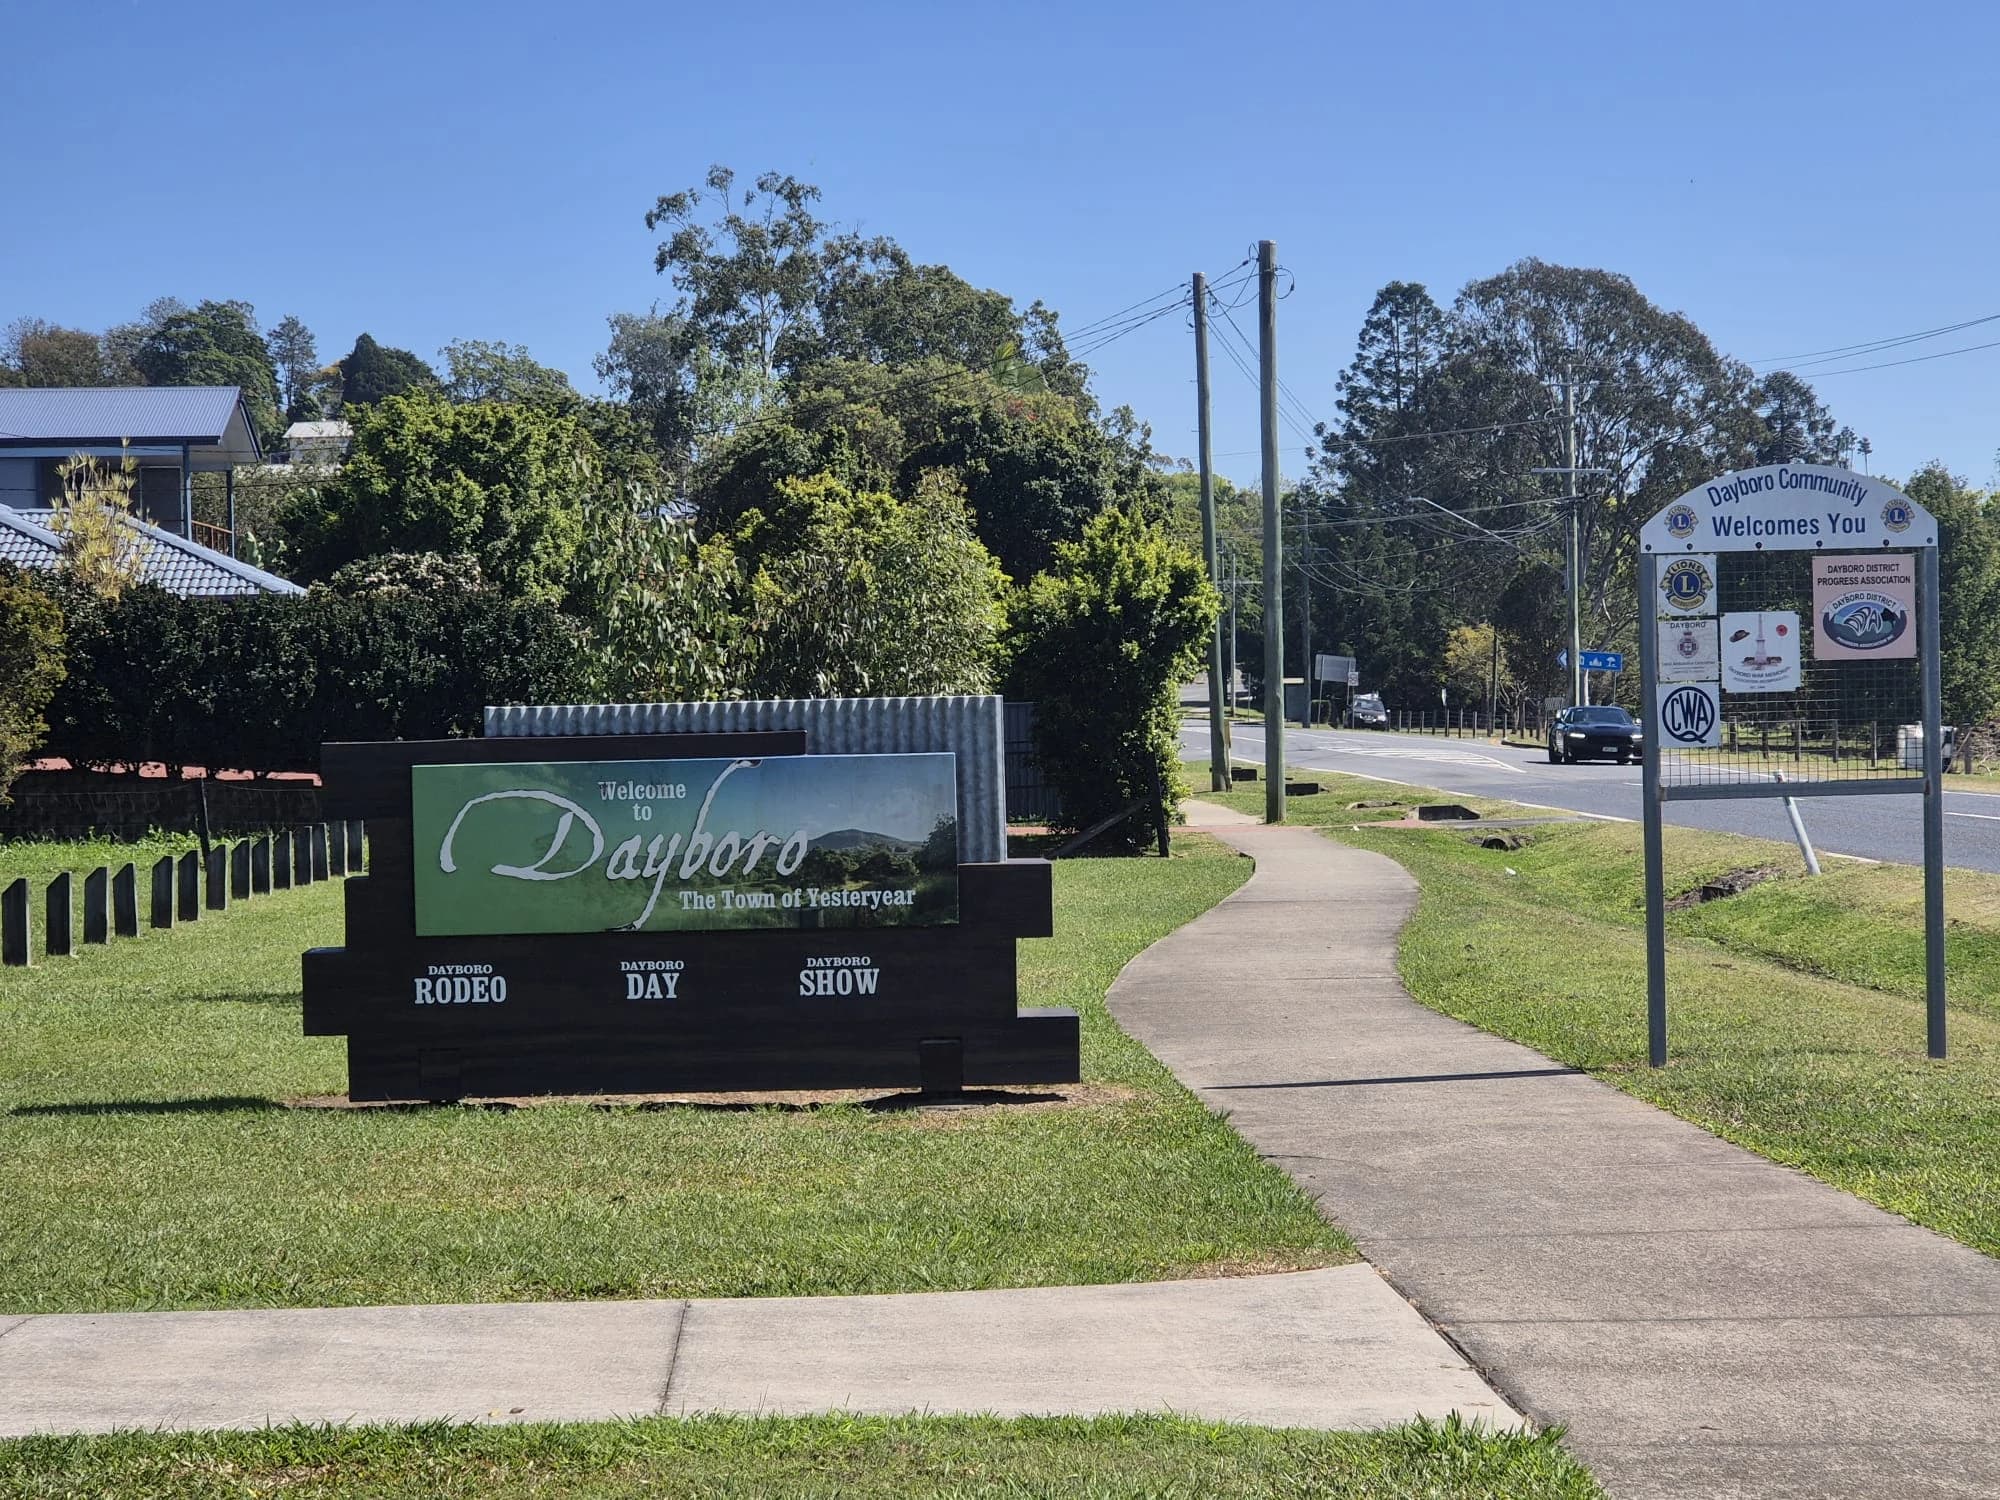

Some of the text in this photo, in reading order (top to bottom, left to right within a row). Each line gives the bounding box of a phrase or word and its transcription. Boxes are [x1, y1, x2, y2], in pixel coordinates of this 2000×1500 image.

[1707, 468, 1868, 507] Dayboro Community
[1712, 512, 1866, 536] Welcomes You
[1671, 561, 1702, 572] LIONS
[1827, 563, 1900, 574] DAYBORO DISTRICT
[1817, 575, 1911, 586] PROGRESS ASSOCIATION
[1832, 593, 1897, 609] DAYBORO DISTRICT
[1670, 621, 1706, 629] DAYBORO
[1671, 691, 1709, 732] CWA
[598, 780, 686, 800] Welcome
[632, 802, 652, 821] to
[440, 760, 809, 930] Dayboro
[679, 887, 917, 911] The Town of Yesteryear
[428, 964, 493, 976] DAYBORO
[620, 960, 685, 971] DAYBORO
[806, 956, 871, 968] DAYBORO
[414, 975, 507, 1004] RODEO
[626, 972, 680, 1000] DAY
[800, 968, 880, 996] SHOW
